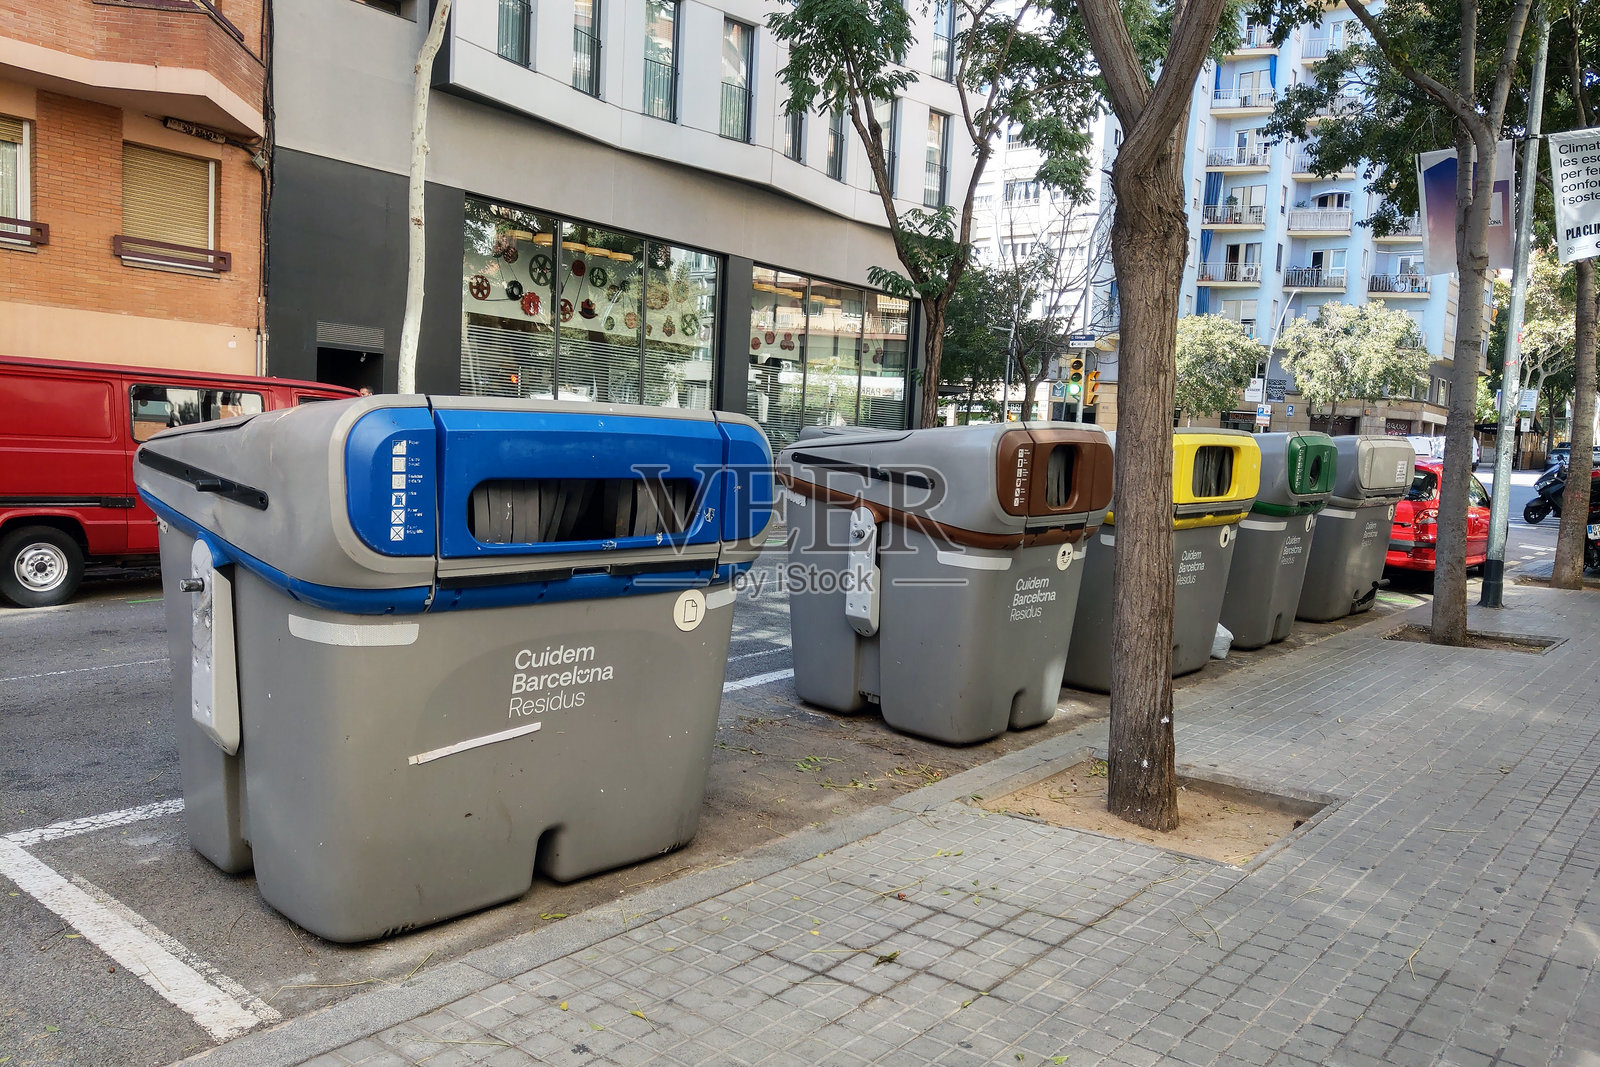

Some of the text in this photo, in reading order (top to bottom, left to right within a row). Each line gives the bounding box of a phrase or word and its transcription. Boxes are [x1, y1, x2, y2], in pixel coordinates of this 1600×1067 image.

[1558, 141, 1600, 155] Climat
[1560, 157, 1578, 168] les
[1560, 169, 1582, 182] per
[1566, 226, 1582, 241] PLA
[1181, 550, 1202, 561] Cuidem
[1178, 561, 1205, 573] Barcelona
[1015, 576, 1050, 592] Cuidem
[1012, 589, 1056, 607] Barcelona
[1010, 605, 1043, 622] Residus
[514, 645, 595, 670] Cuidem
[511, 665, 614, 695] Barcelona
[508, 690, 586, 719] Residus
